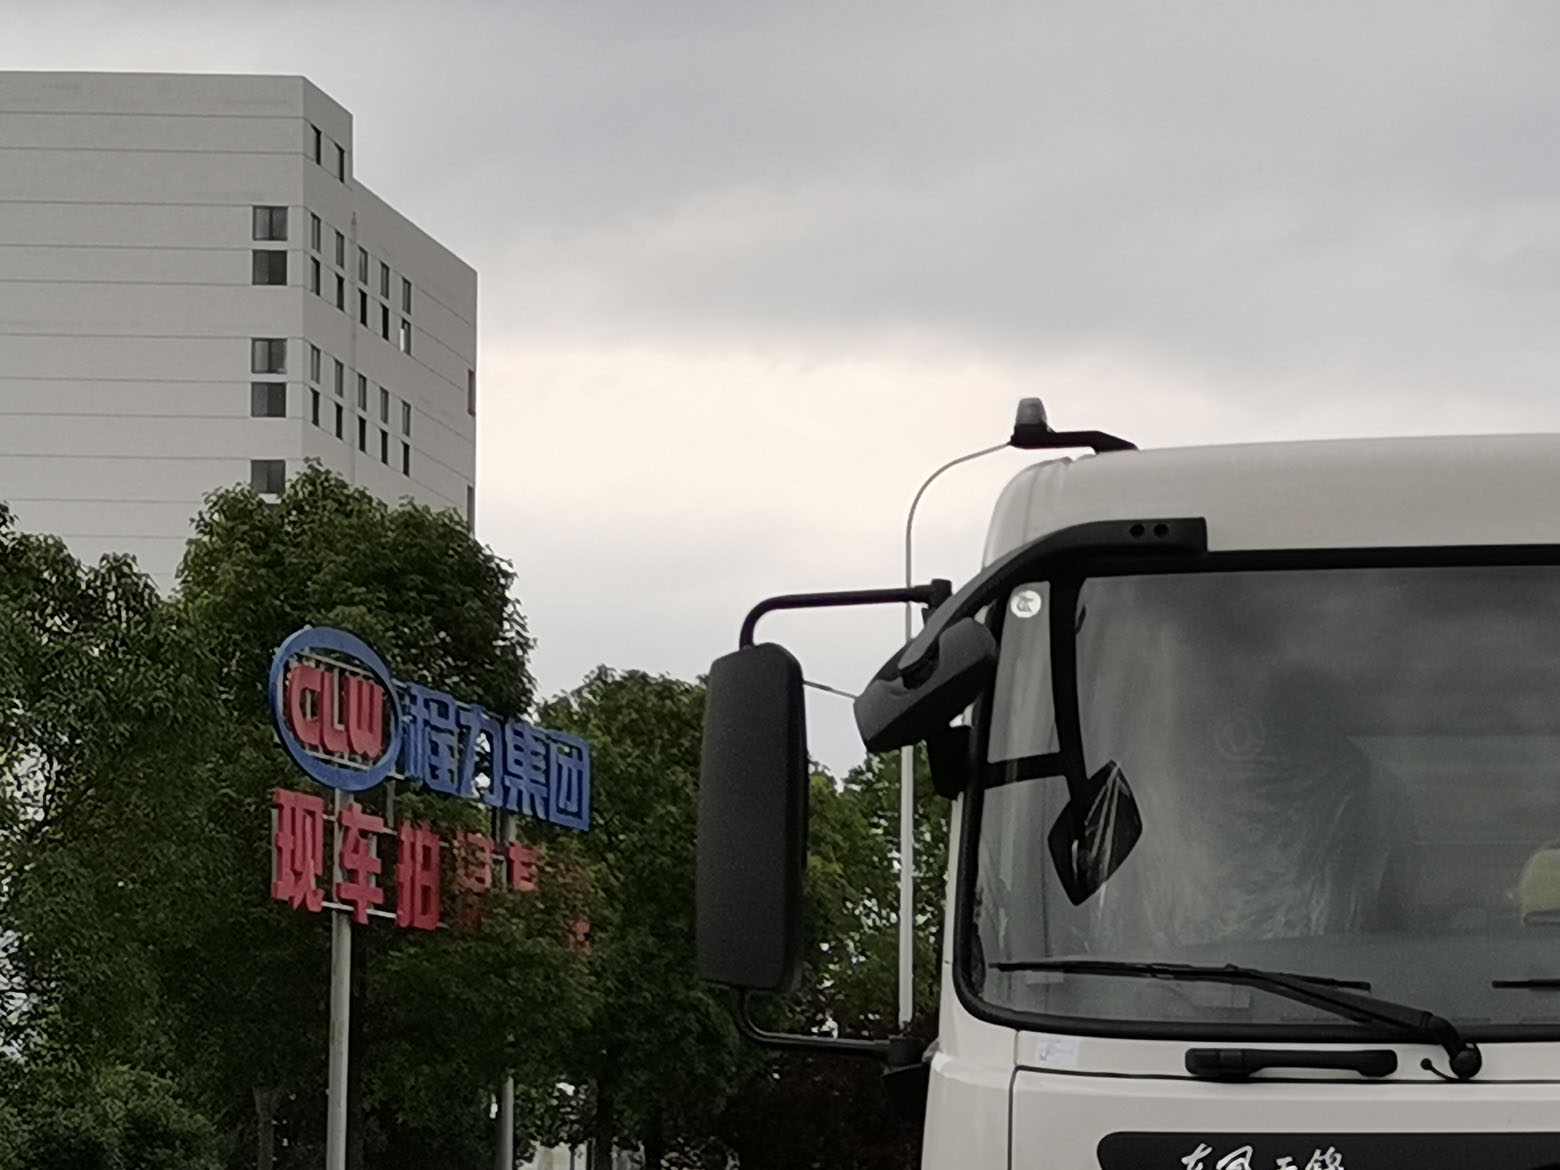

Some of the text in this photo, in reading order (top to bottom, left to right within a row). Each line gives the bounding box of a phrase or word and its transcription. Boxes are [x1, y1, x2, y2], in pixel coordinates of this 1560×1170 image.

[287, 665, 384, 757] CLW
[402, 682, 590, 831] 程力集团
